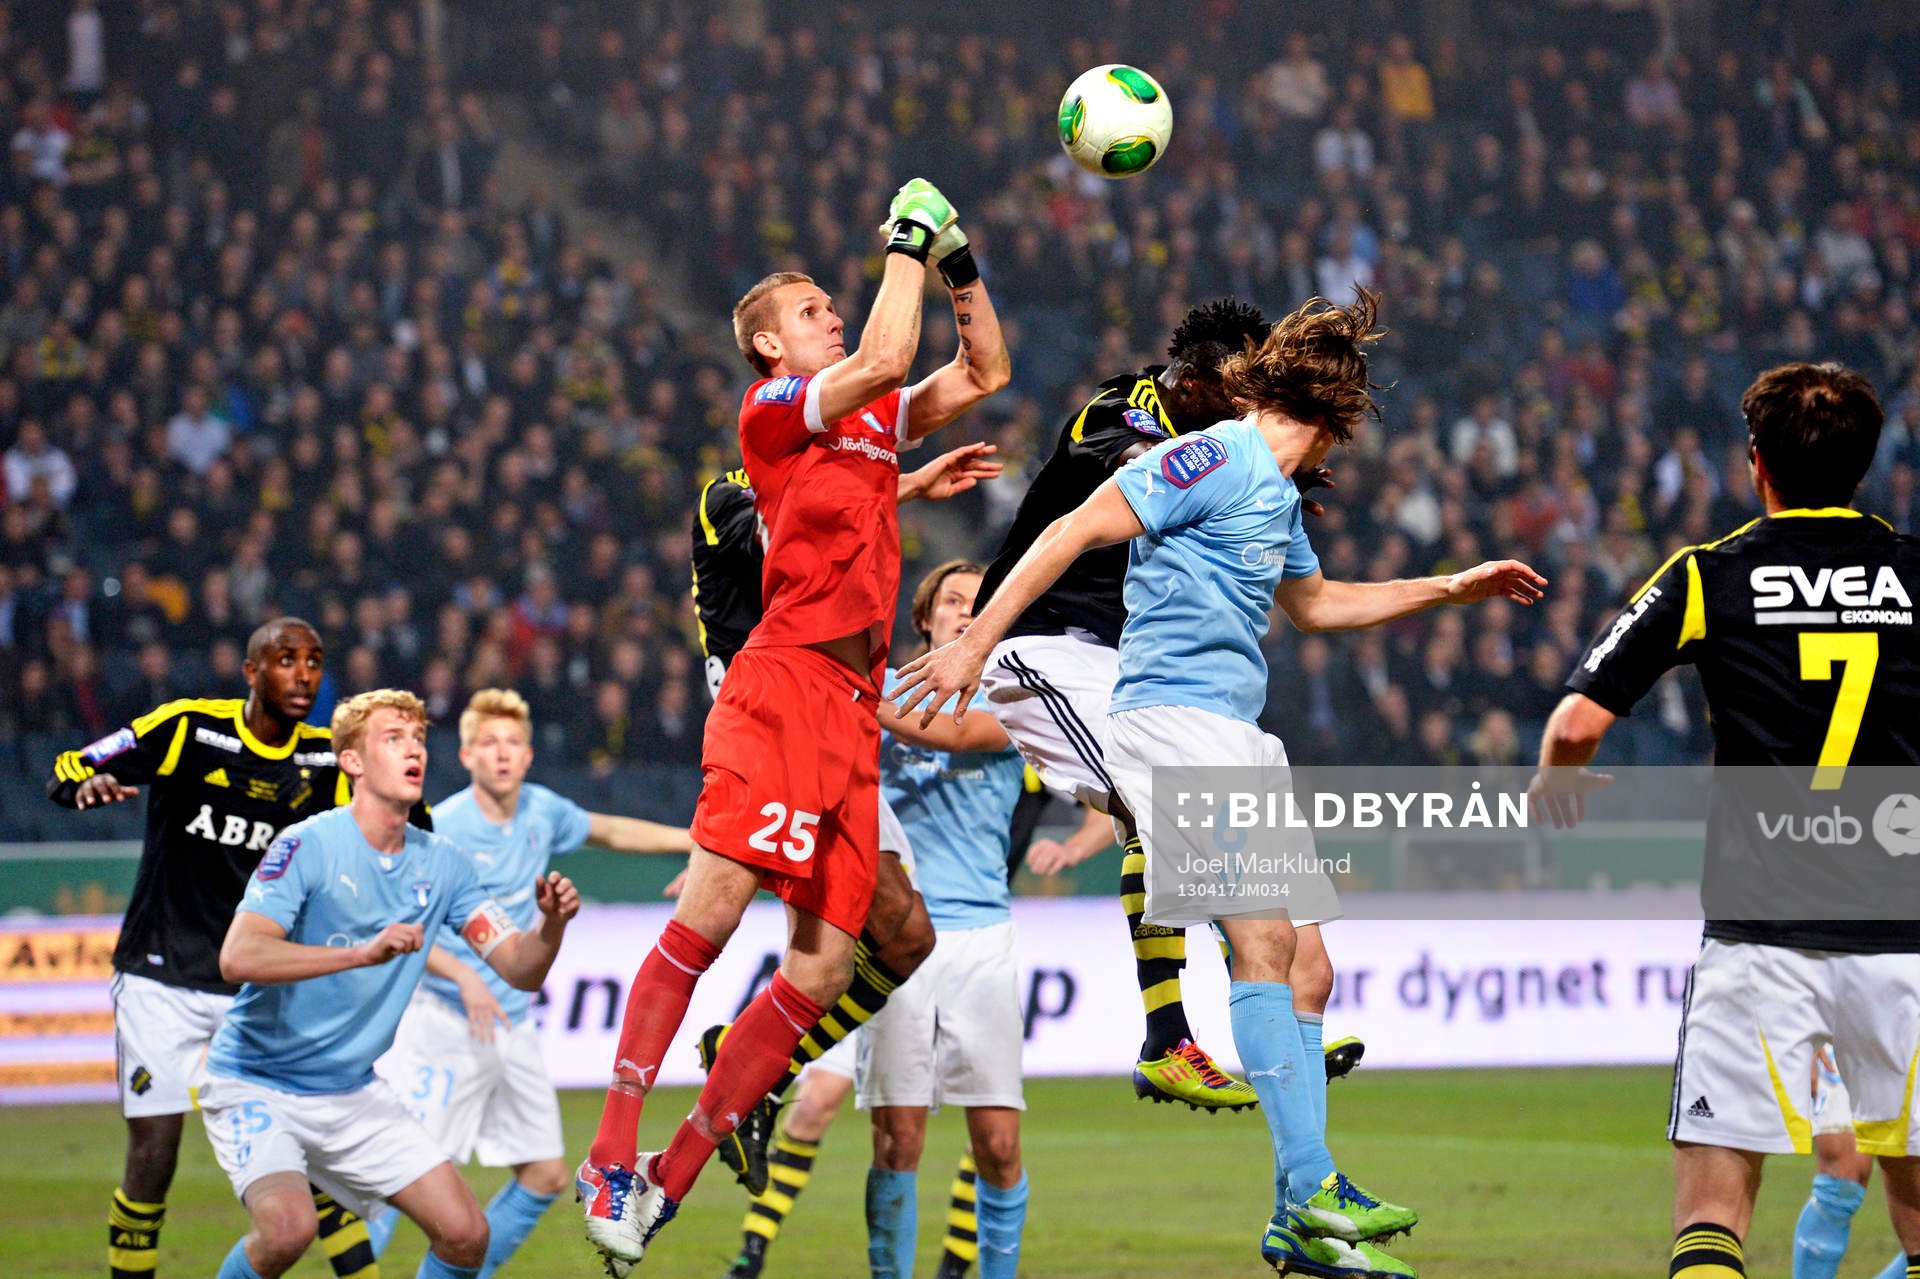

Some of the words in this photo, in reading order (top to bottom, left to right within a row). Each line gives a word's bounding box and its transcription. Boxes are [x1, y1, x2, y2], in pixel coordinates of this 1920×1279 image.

[1750, 565, 1913, 609] SVEA
[1840, 610, 1913, 625] EKONOMI
[1798, 632, 1880, 790] 7
[185, 804, 274, 851] ÅBR
[748, 801, 820, 862] 25
[1756, 805, 1863, 845] vuab
[1398, 952, 1609, 1021] dygnet
[1637, 965, 1690, 1003] ru
[411, 1065, 454, 1109] 31
[229, 1100, 272, 1145] 15
